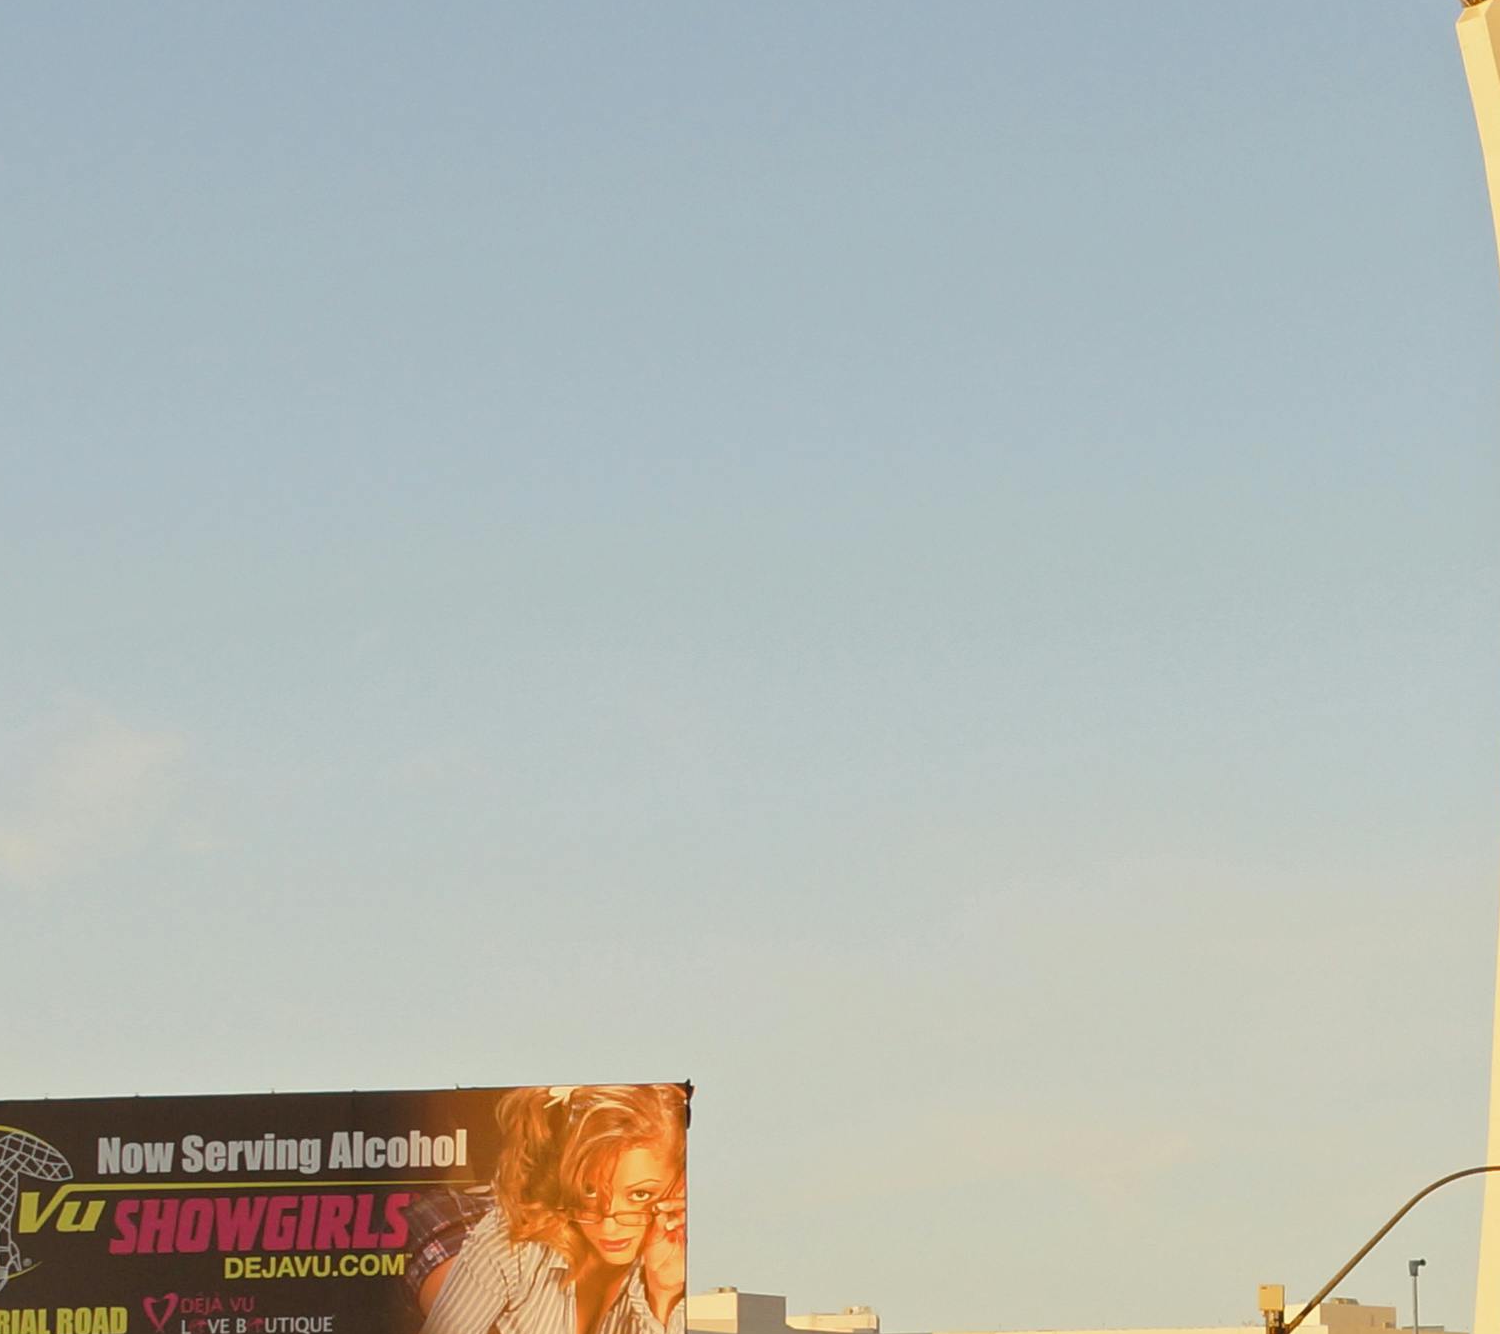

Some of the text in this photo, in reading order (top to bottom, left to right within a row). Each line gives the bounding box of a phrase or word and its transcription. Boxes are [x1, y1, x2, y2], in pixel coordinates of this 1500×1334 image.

[98, 1129, 467, 1175] Now Serving Alcohol
[18, 1191, 107, 1234] Vu
[108, 1193, 412, 1254] SHOWGIRLS
[224, 1254, 405, 1280] DEJAVU.COM
[229, 1296, 255, 1313] VU
